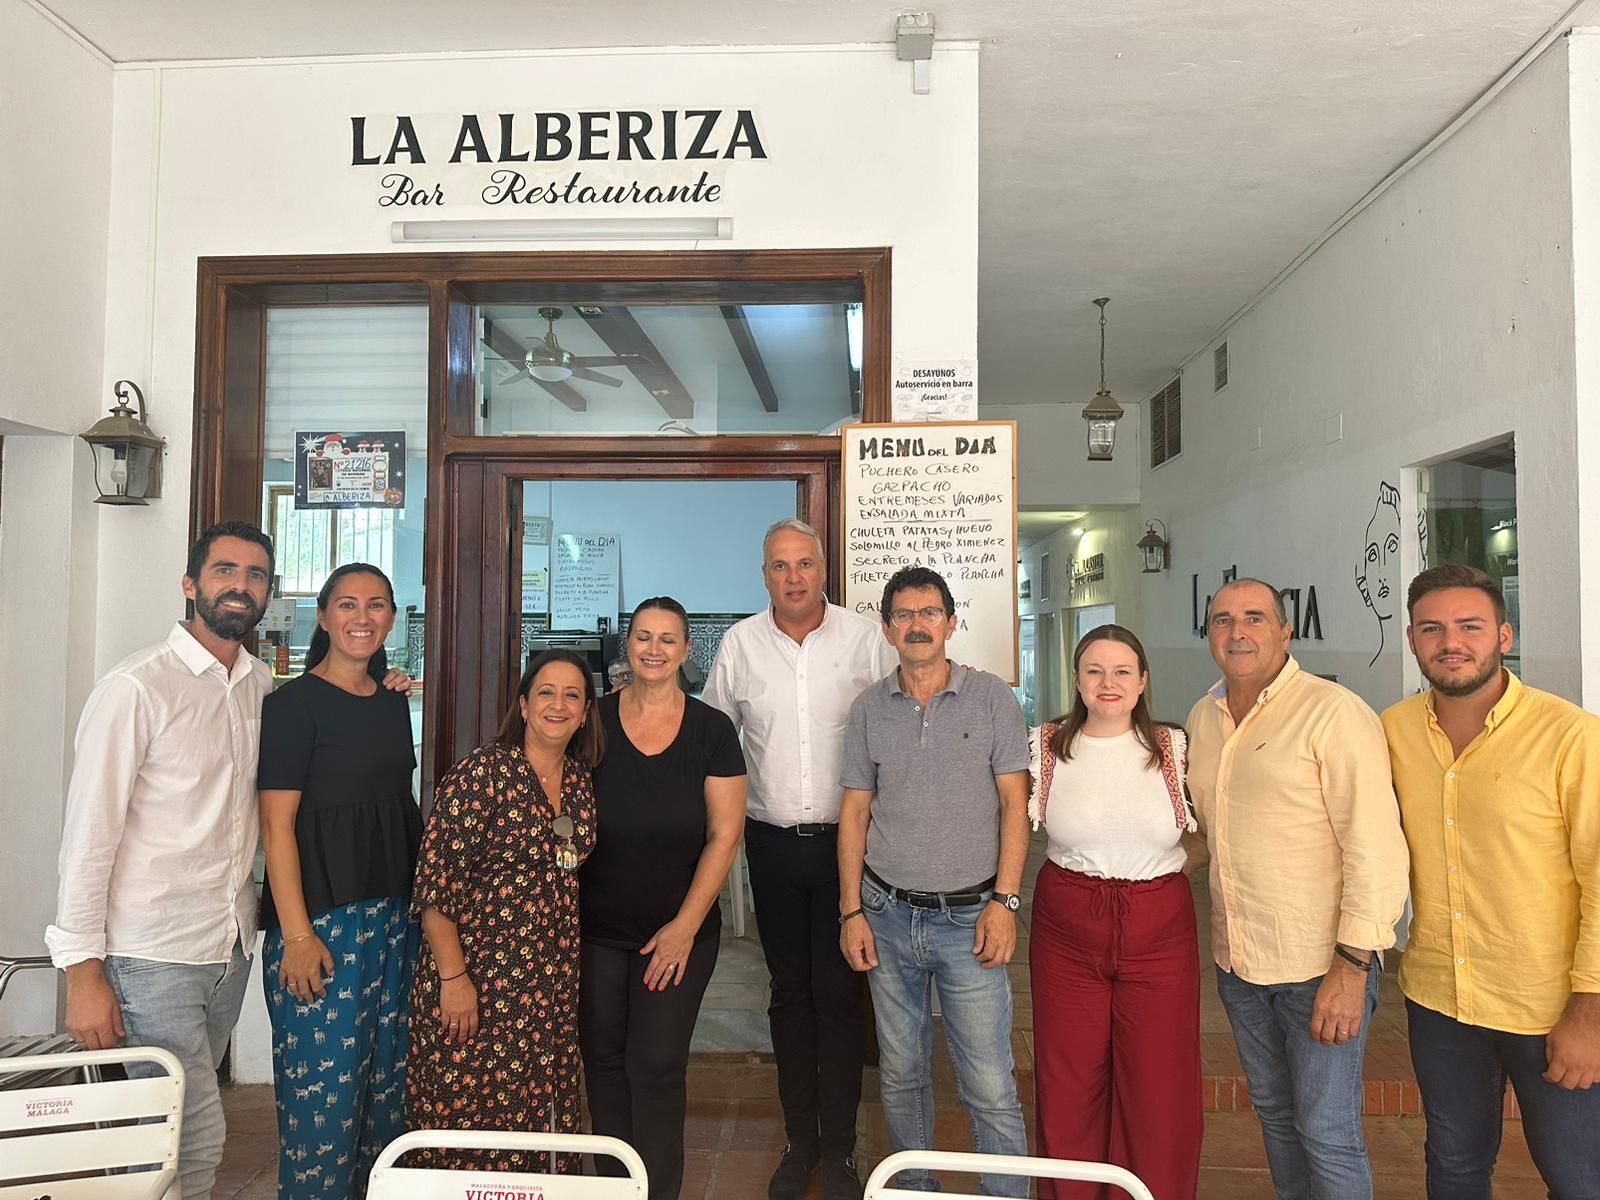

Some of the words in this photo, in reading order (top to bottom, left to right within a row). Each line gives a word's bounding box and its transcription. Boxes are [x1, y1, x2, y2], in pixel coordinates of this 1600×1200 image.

[351, 115, 426, 166] LA
[448, 110, 768, 163] ALBERIZA
[378, 173, 445, 207] Bar
[481, 169, 721, 205] Restaurante
[912, 369, 956, 378] DESAYUNOS
[895, 380, 941, 389] Autoservicio
[952, 380, 973, 388] barra
[921, 393, 948, 401] ¡Gracias!
[859, 437, 925, 460] MENU
[928, 448, 949, 457] DEL
[955, 436, 997, 455] DIA
[859, 463, 918, 478] PUCHERO
[925, 463, 979, 476] CASERO
[872, 481, 951, 494] GAZPACHO
[858, 495, 946, 507] ENTREMESES
[952, 491, 1003, 507] VARIADOS
[860, 508, 917, 520] ENSALADA
[923, 507, 966, 519] MIXTA
[850, 527, 895, 539] CHULETA
[902, 526, 947, 536] PATATAS
[956, 524, 992, 535] HUEVO
[850, 541, 900, 551] SOLOMILLO
[922, 537, 952, 551] PEDRO
[956, 537, 1006, 548] XIMENEZ
[853, 555, 910, 567] SECRETO
[942, 552, 996, 566] PLANCHA
[960, 566, 1004, 580] PLANCHA
[26, 1100, 73, 1110] VICTORIA
[465, 1190, 544, 1200] VICTORIA
